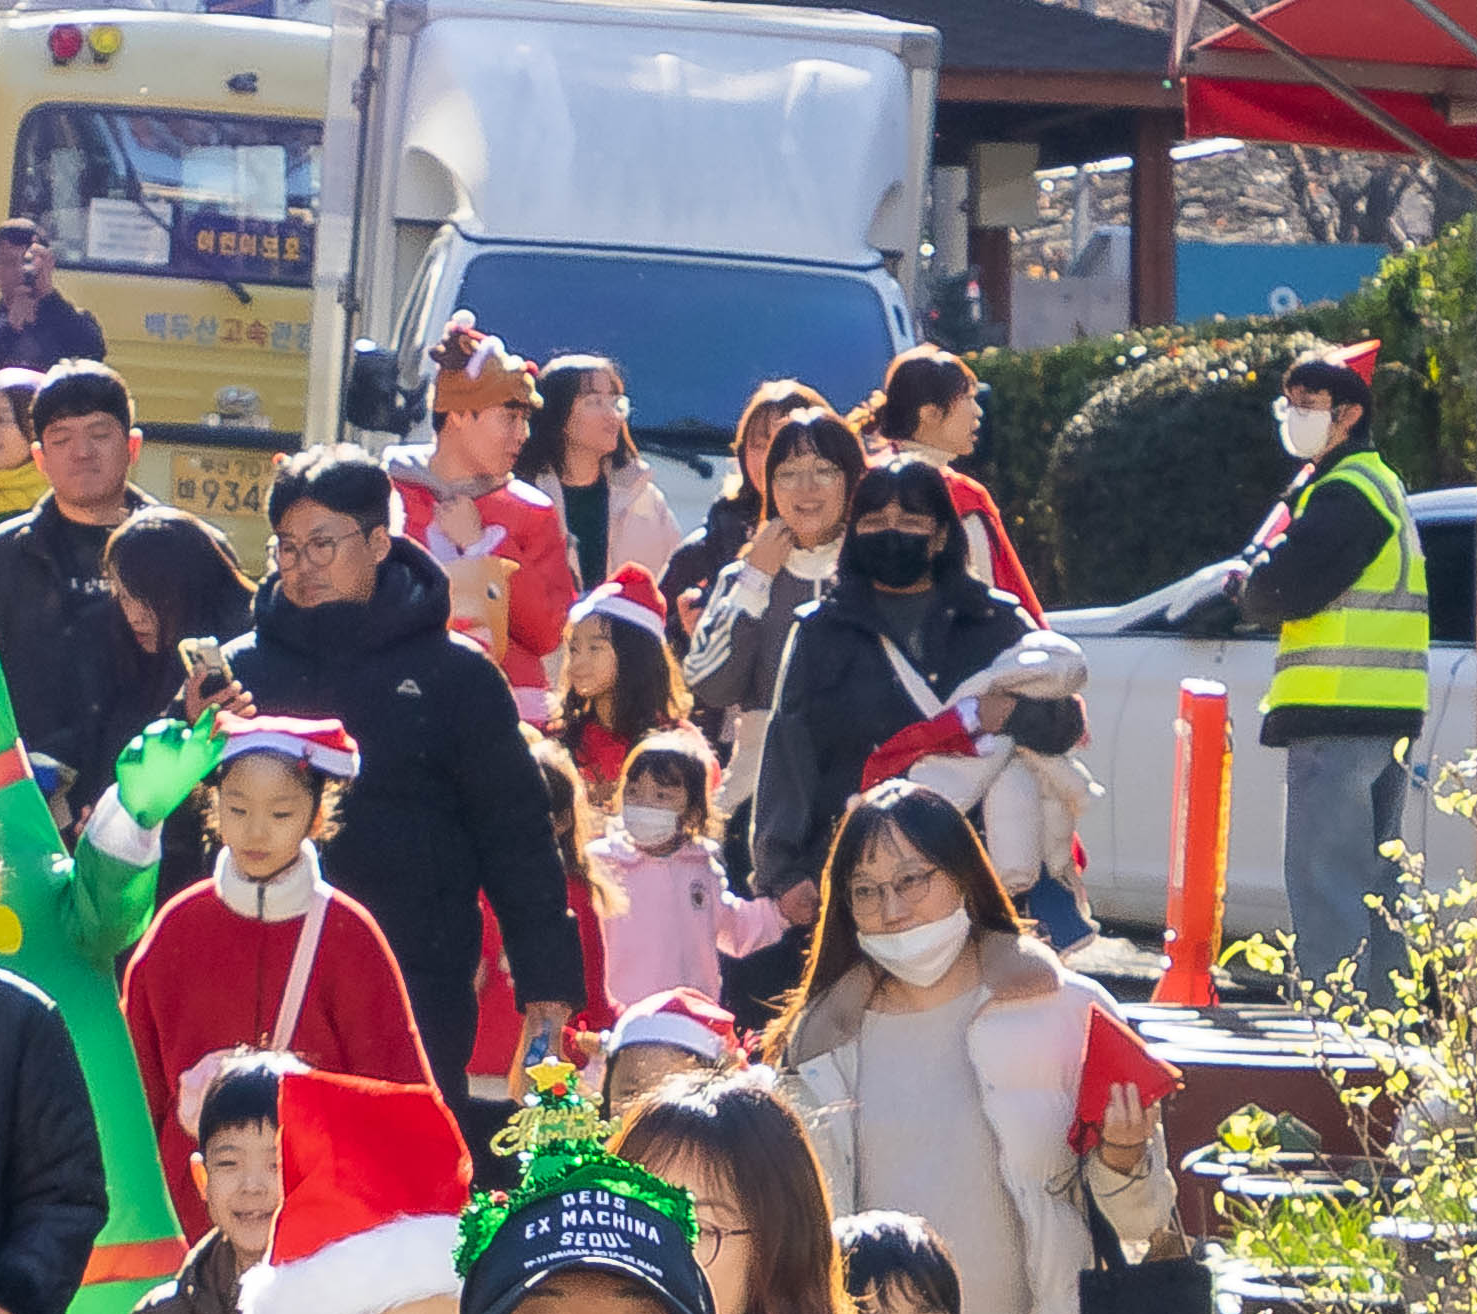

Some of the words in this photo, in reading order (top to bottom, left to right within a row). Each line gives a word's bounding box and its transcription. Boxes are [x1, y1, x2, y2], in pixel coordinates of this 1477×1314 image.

[561, 1190, 626, 1212] DEUS
[524, 1216, 551, 1240] EX
[561, 1211, 660, 1245] MACHINA
[559, 1232, 632, 1249] SEOUL
